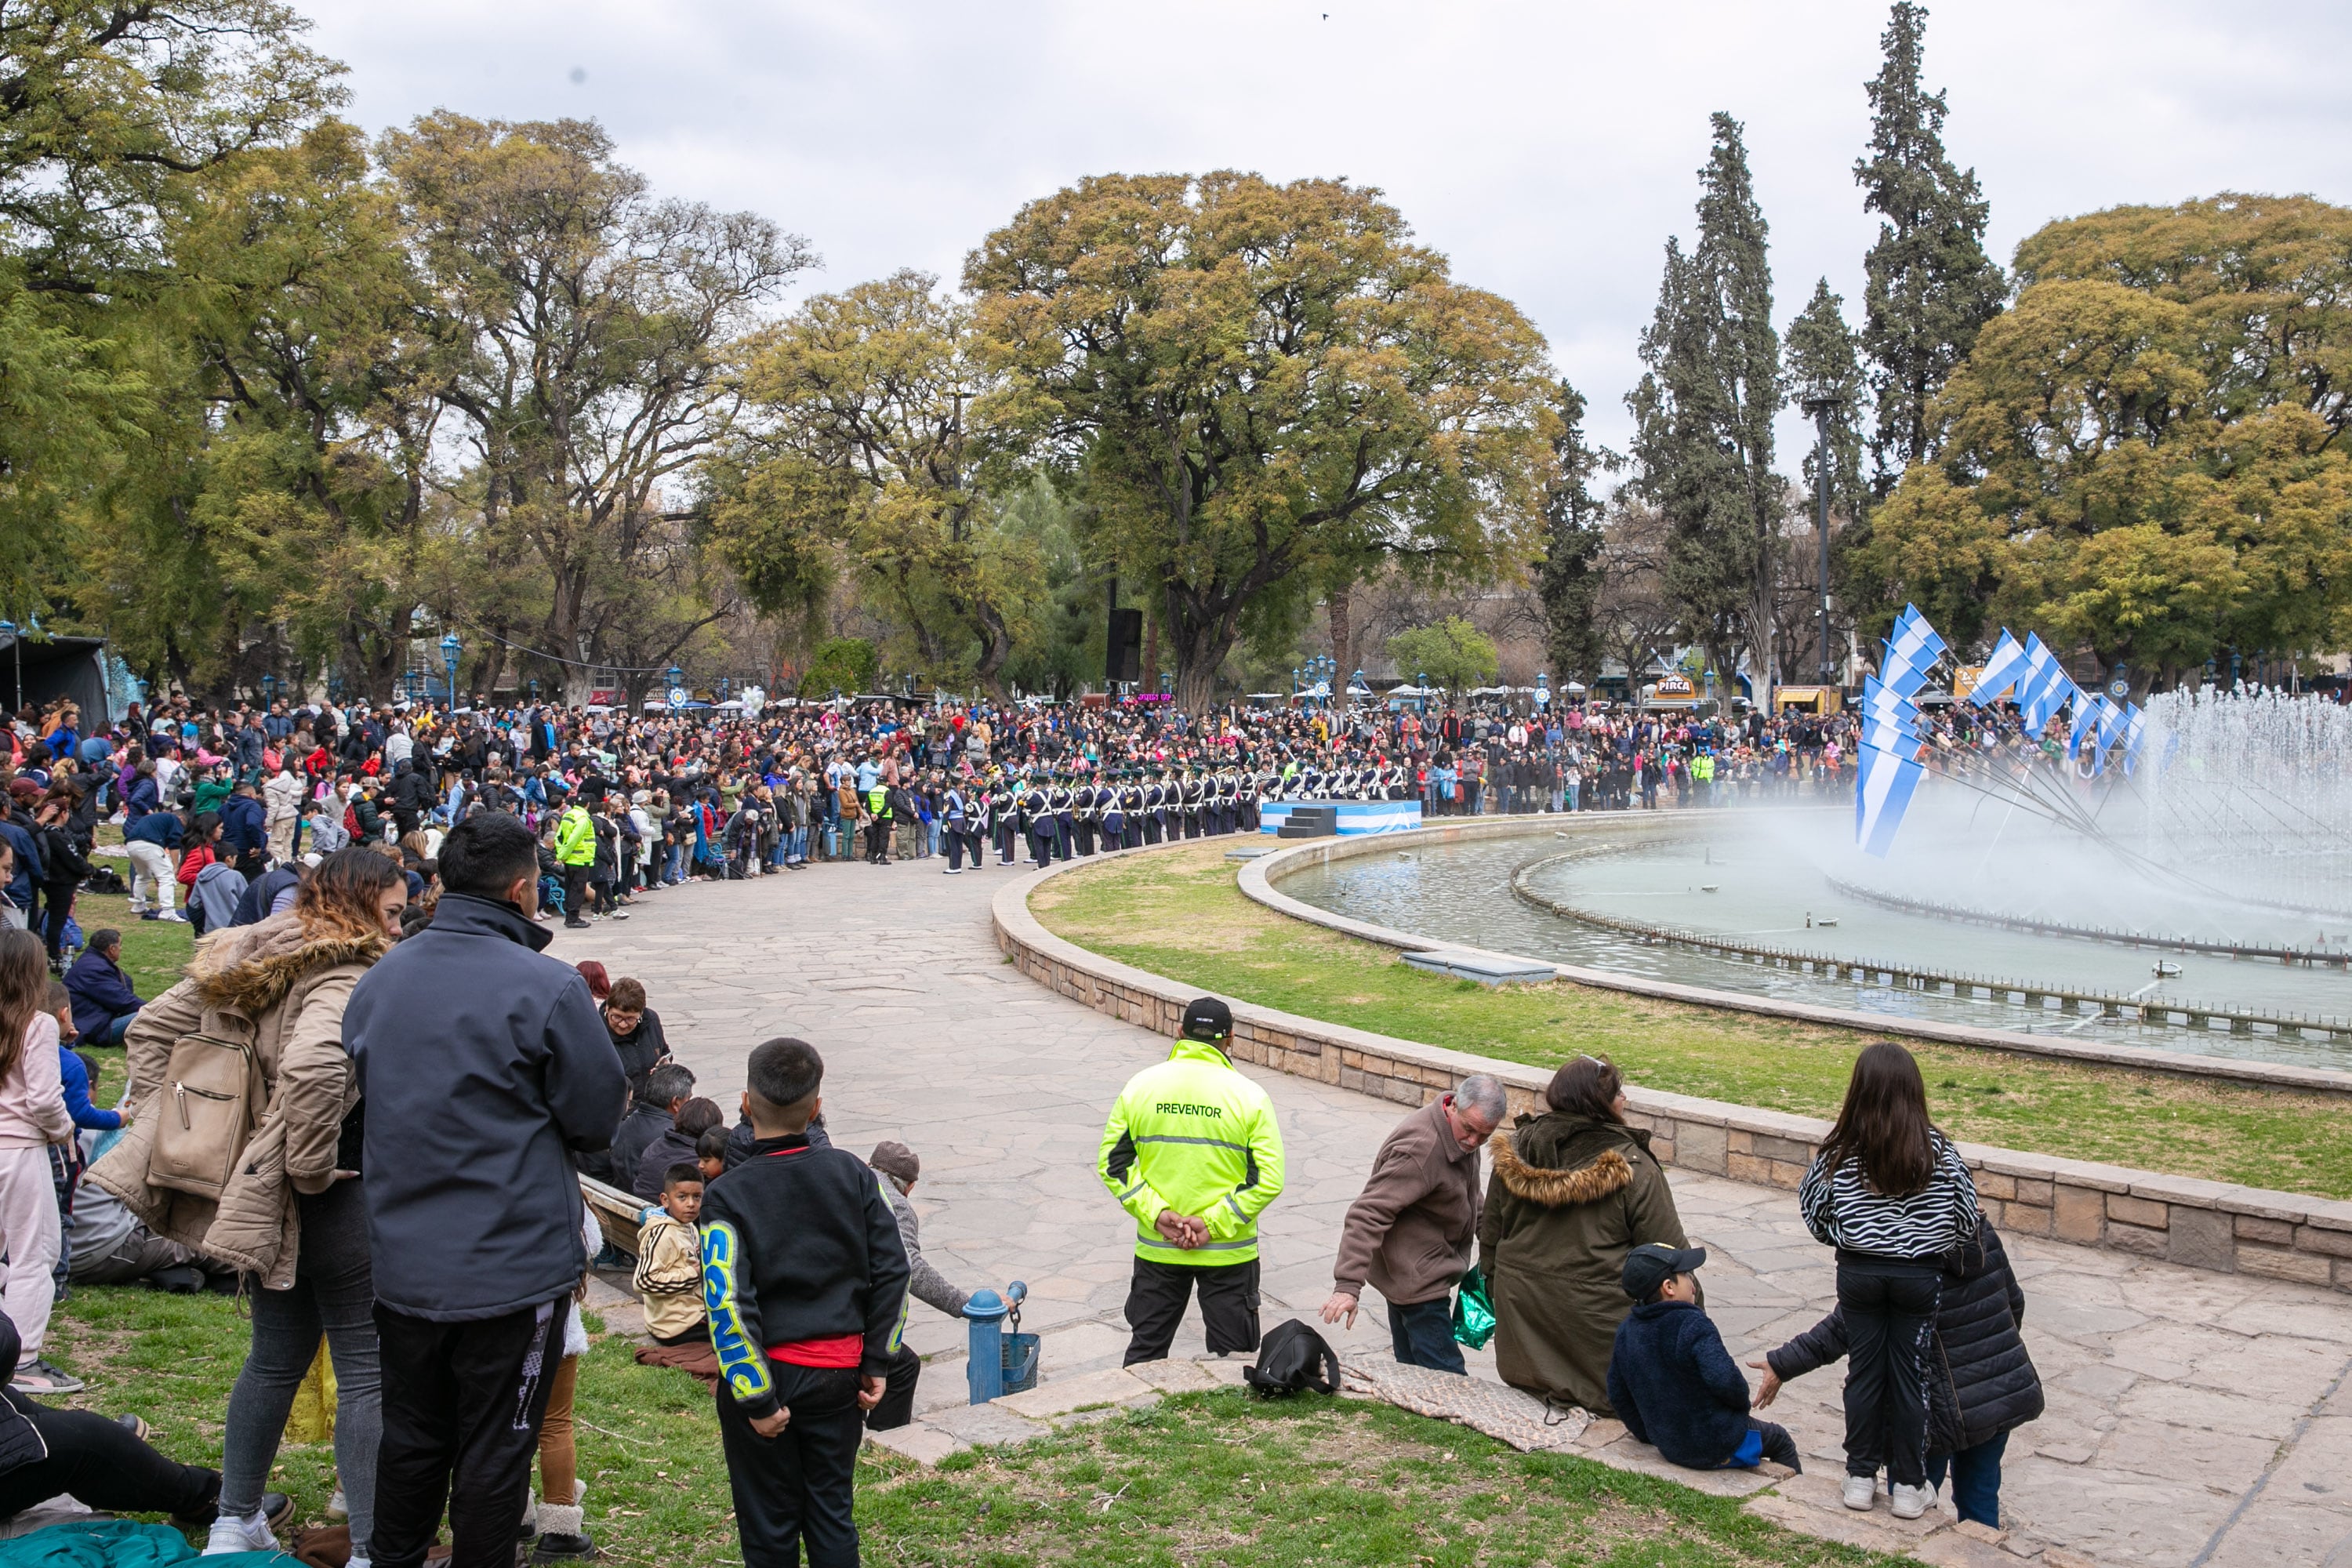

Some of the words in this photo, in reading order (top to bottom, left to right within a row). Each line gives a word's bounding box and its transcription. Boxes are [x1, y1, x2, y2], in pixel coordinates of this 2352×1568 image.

[1659, 681, 1690, 691] PIRCA
[1156, 1103, 1221, 1119] PREVENTOR
[701, 1228, 766, 1395] SONIC
